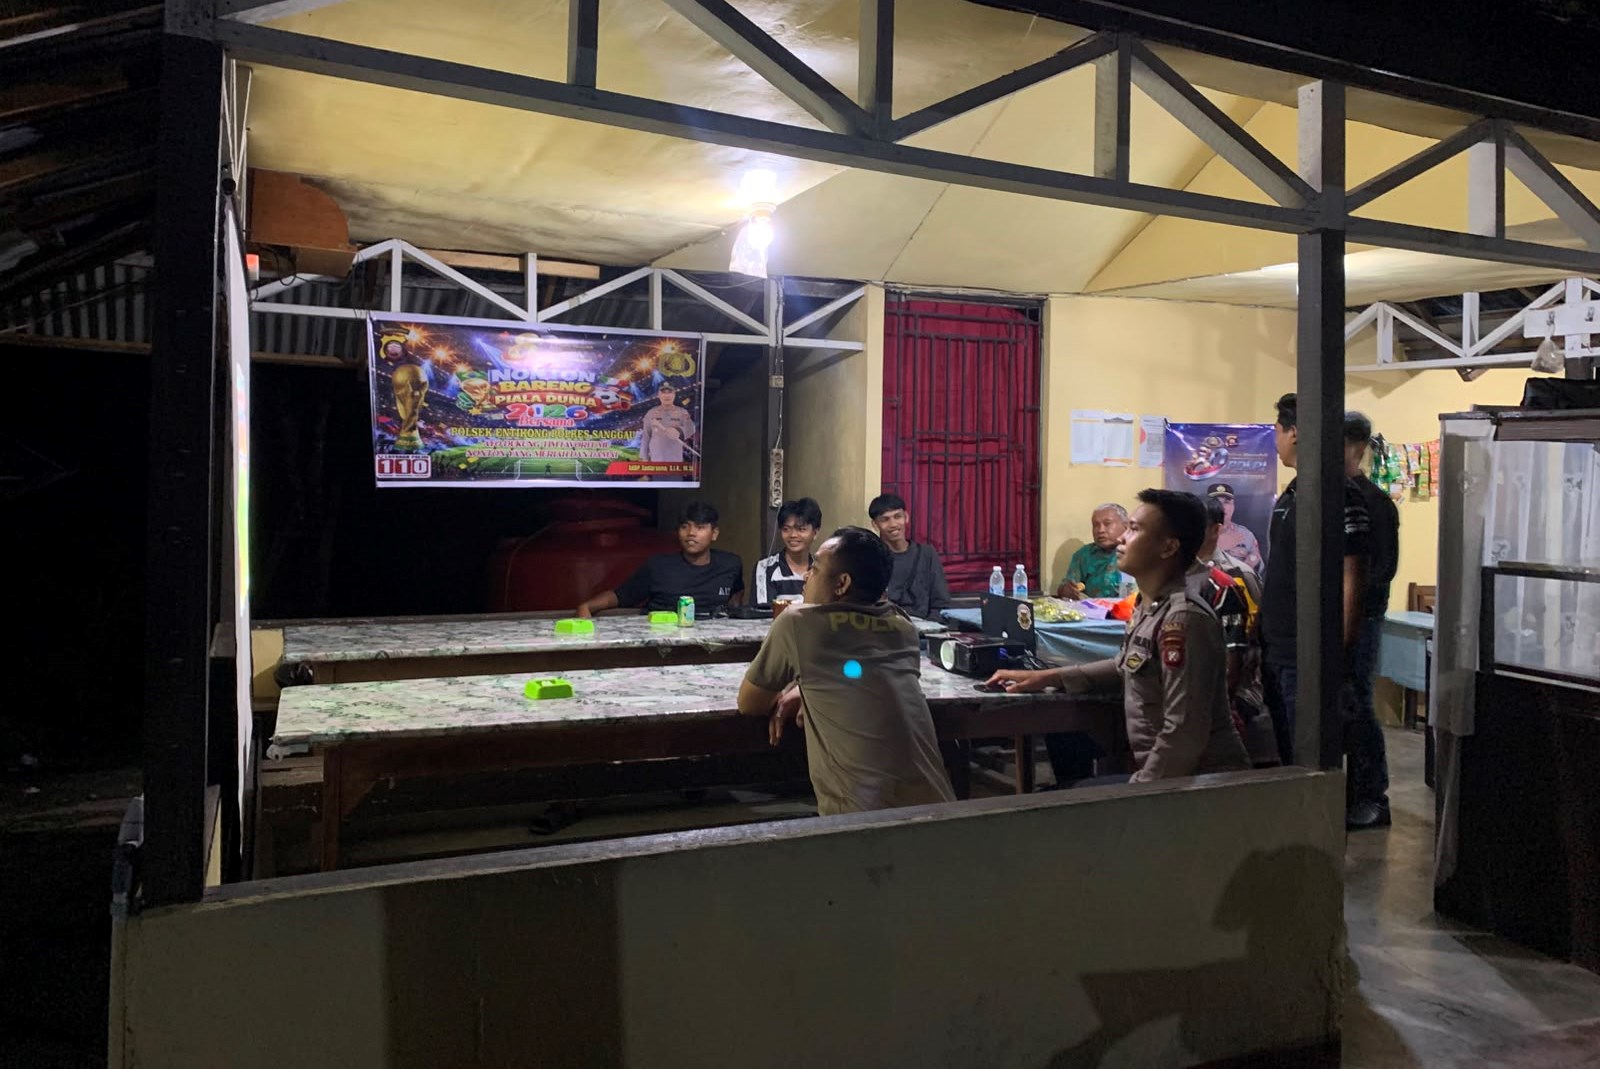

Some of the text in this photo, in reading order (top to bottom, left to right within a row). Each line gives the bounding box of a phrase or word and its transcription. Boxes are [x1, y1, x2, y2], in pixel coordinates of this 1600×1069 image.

[489, 368, 597, 382] NONTON
[499, 380, 592, 393] BARENG
[495, 394, 597, 407] PIALA DUNIA
[505, 403, 588, 420] 2026
[519, 415, 575, 427] Bersama
[451, 427, 635, 440] POLSEK ENTIKONG POLRES SANGGAU
[381, 460, 427, 474] 110
